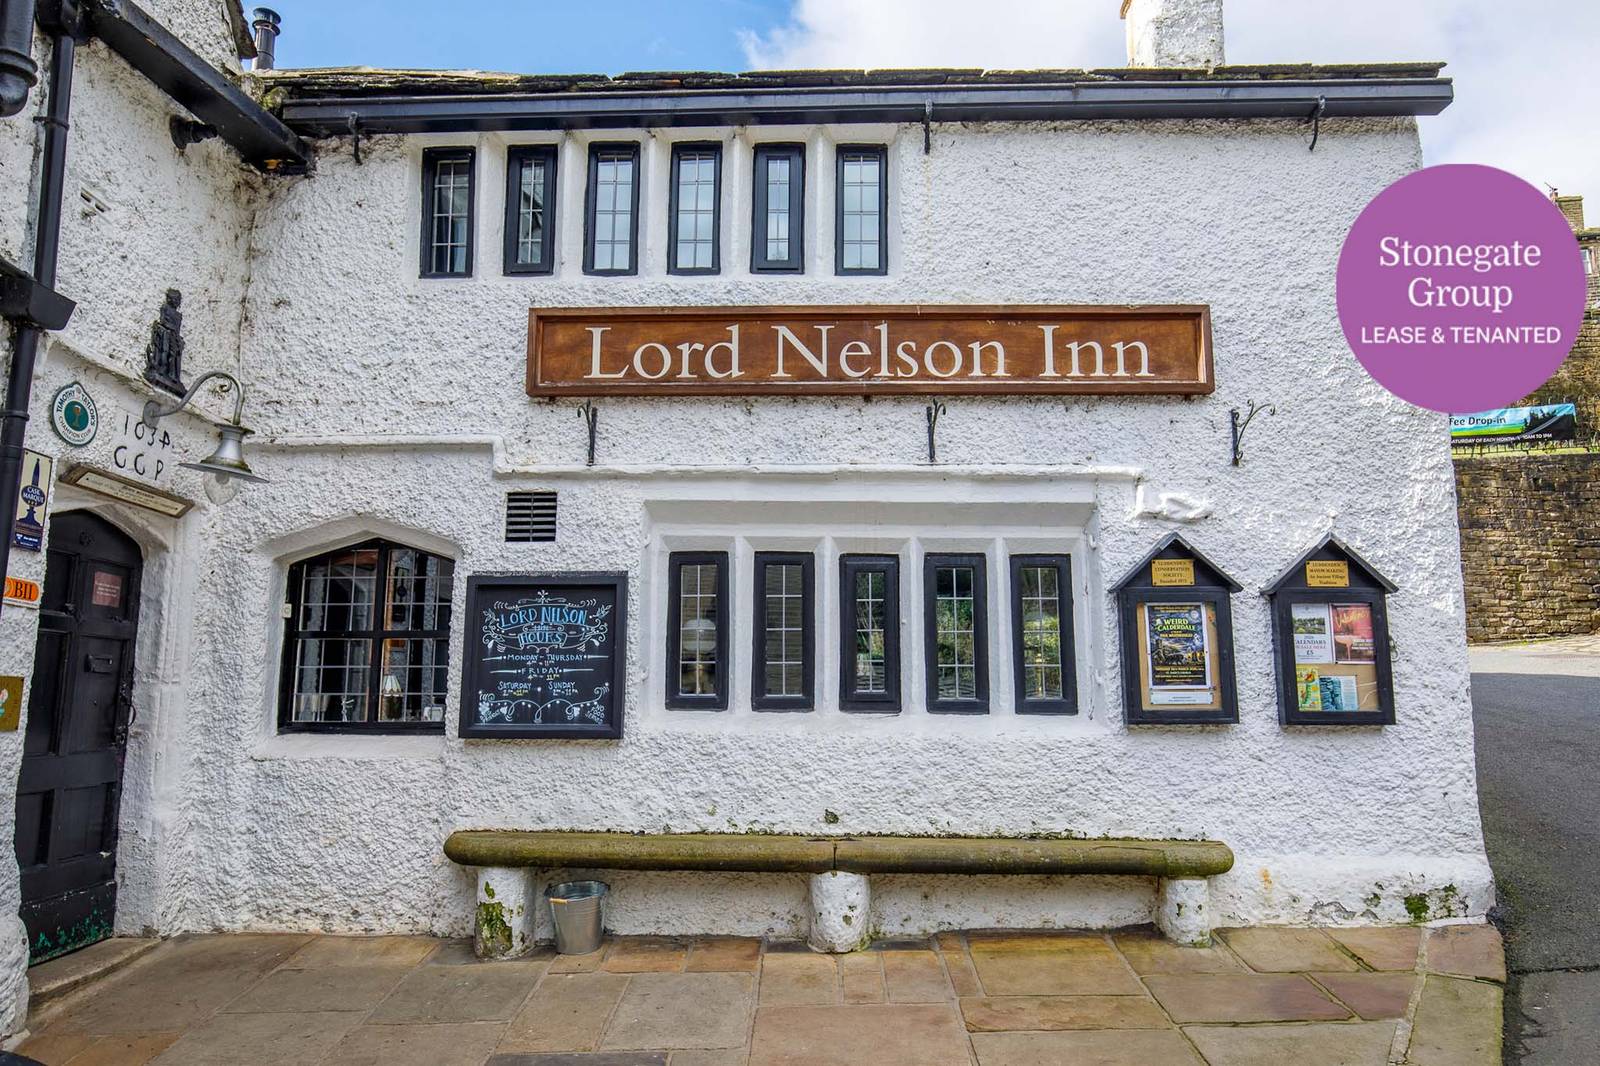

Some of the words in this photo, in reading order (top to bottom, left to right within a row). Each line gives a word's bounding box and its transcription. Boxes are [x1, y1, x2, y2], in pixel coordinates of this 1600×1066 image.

[584, 324, 745, 379] Lord
[770, 323, 1011, 378] Nelson
[1038, 325, 1155, 377] Inn
[1468, 415, 1506, 426] Drop-in
[501, 608, 538, 628] LORD
[521, 632, 562, 644] HOURS
[546, 653, 583, 661] THURSDAY
[521, 666, 559, 674] FRIDAY
[498, 681, 532, 691] SATURDAY
[548, 681, 576, 690] SUNDAY
